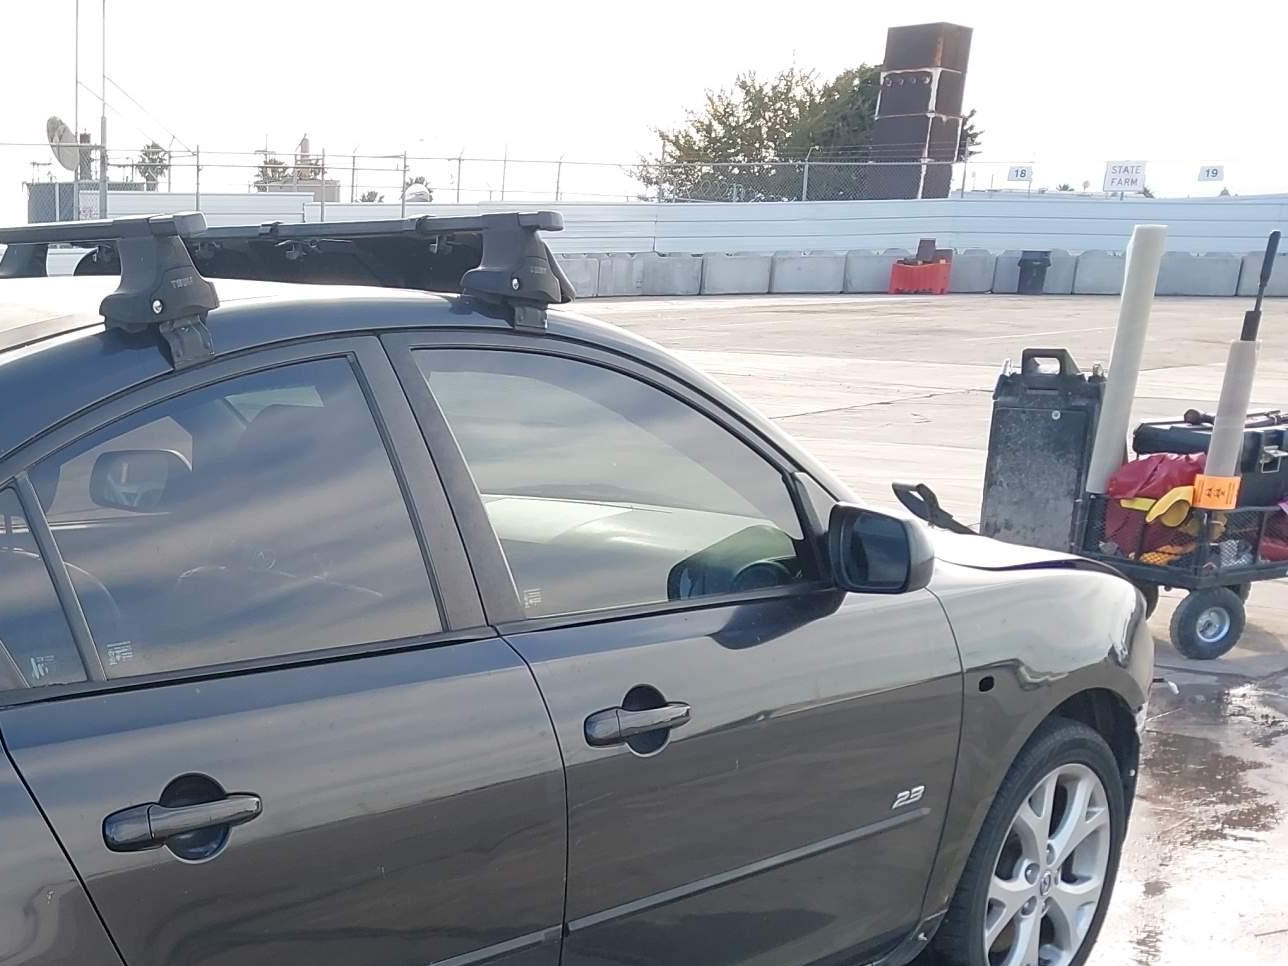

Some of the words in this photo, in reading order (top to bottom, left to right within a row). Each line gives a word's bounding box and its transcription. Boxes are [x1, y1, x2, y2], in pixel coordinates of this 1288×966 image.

[1014, 168, 1027, 178] 18
[1111, 165, 1142, 175] STATE
[1206, 168, 1218, 178] 19
[1111, 177, 1138, 186] FARM
